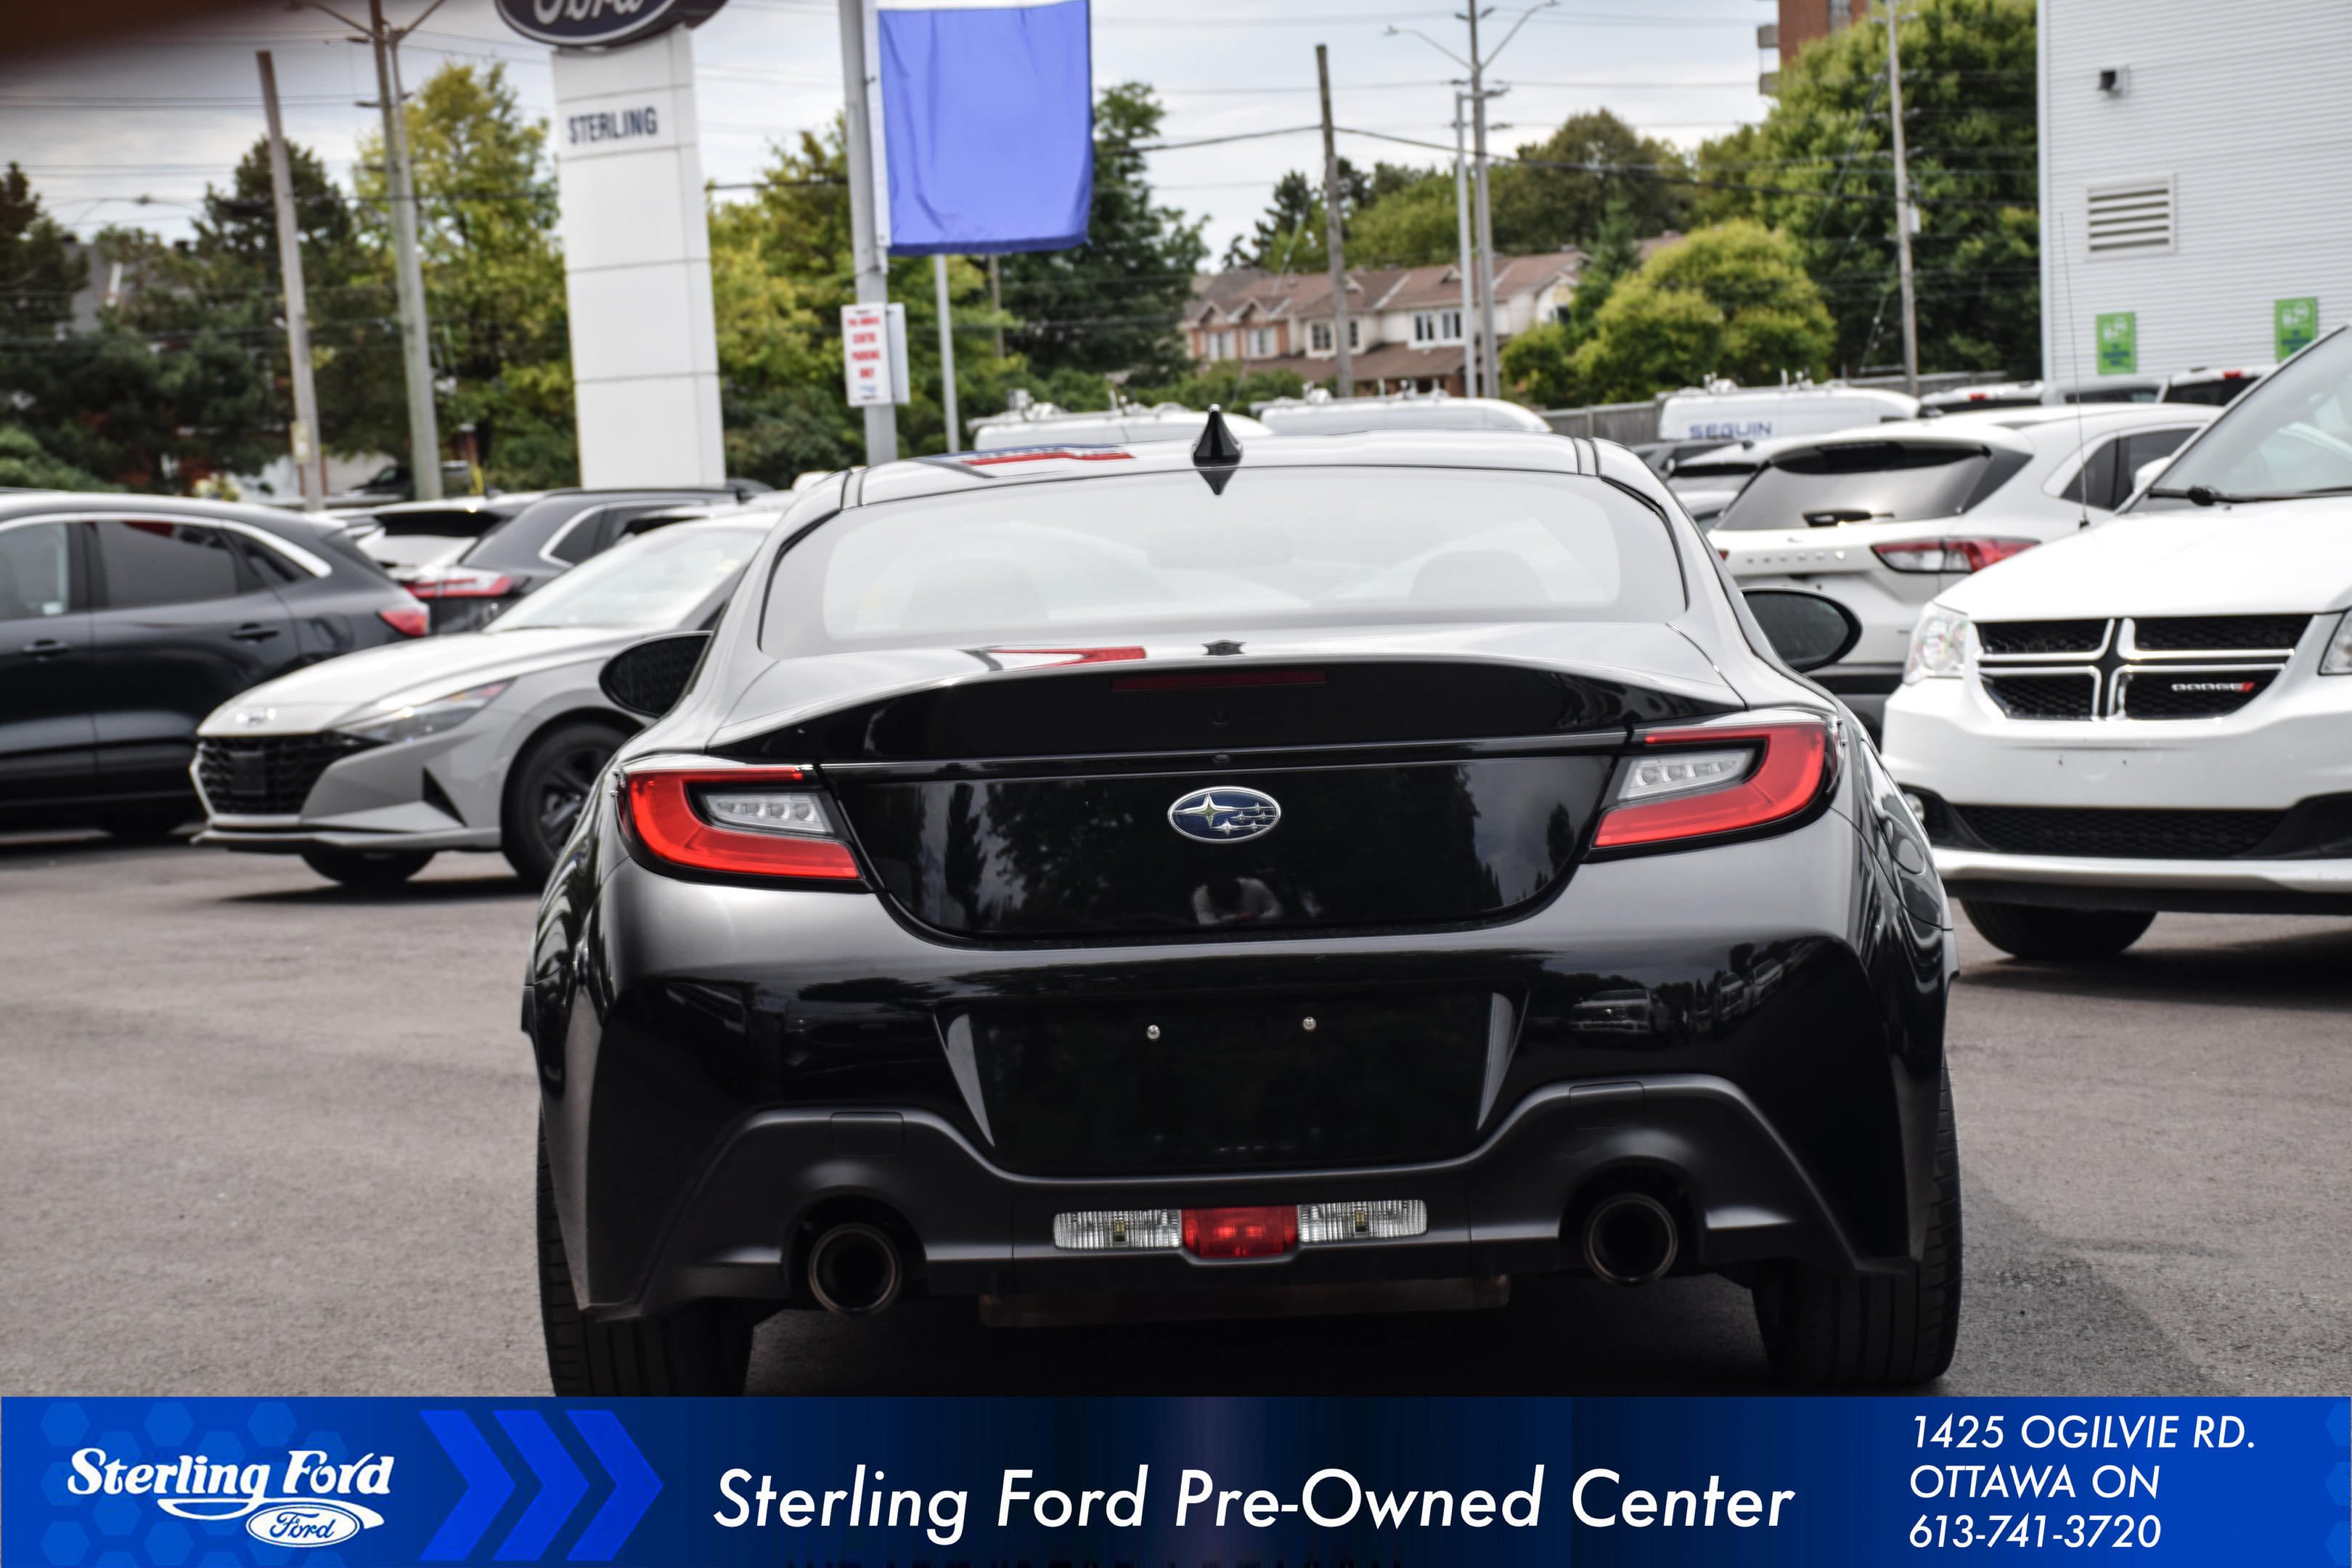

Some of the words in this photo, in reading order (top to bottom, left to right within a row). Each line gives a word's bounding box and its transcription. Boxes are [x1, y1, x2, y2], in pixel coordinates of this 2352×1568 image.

[568, 107, 658, 144] STERLING
[1689, 422, 1773, 439] SEGUIN
[2171, 683, 2244, 692] DODGE
